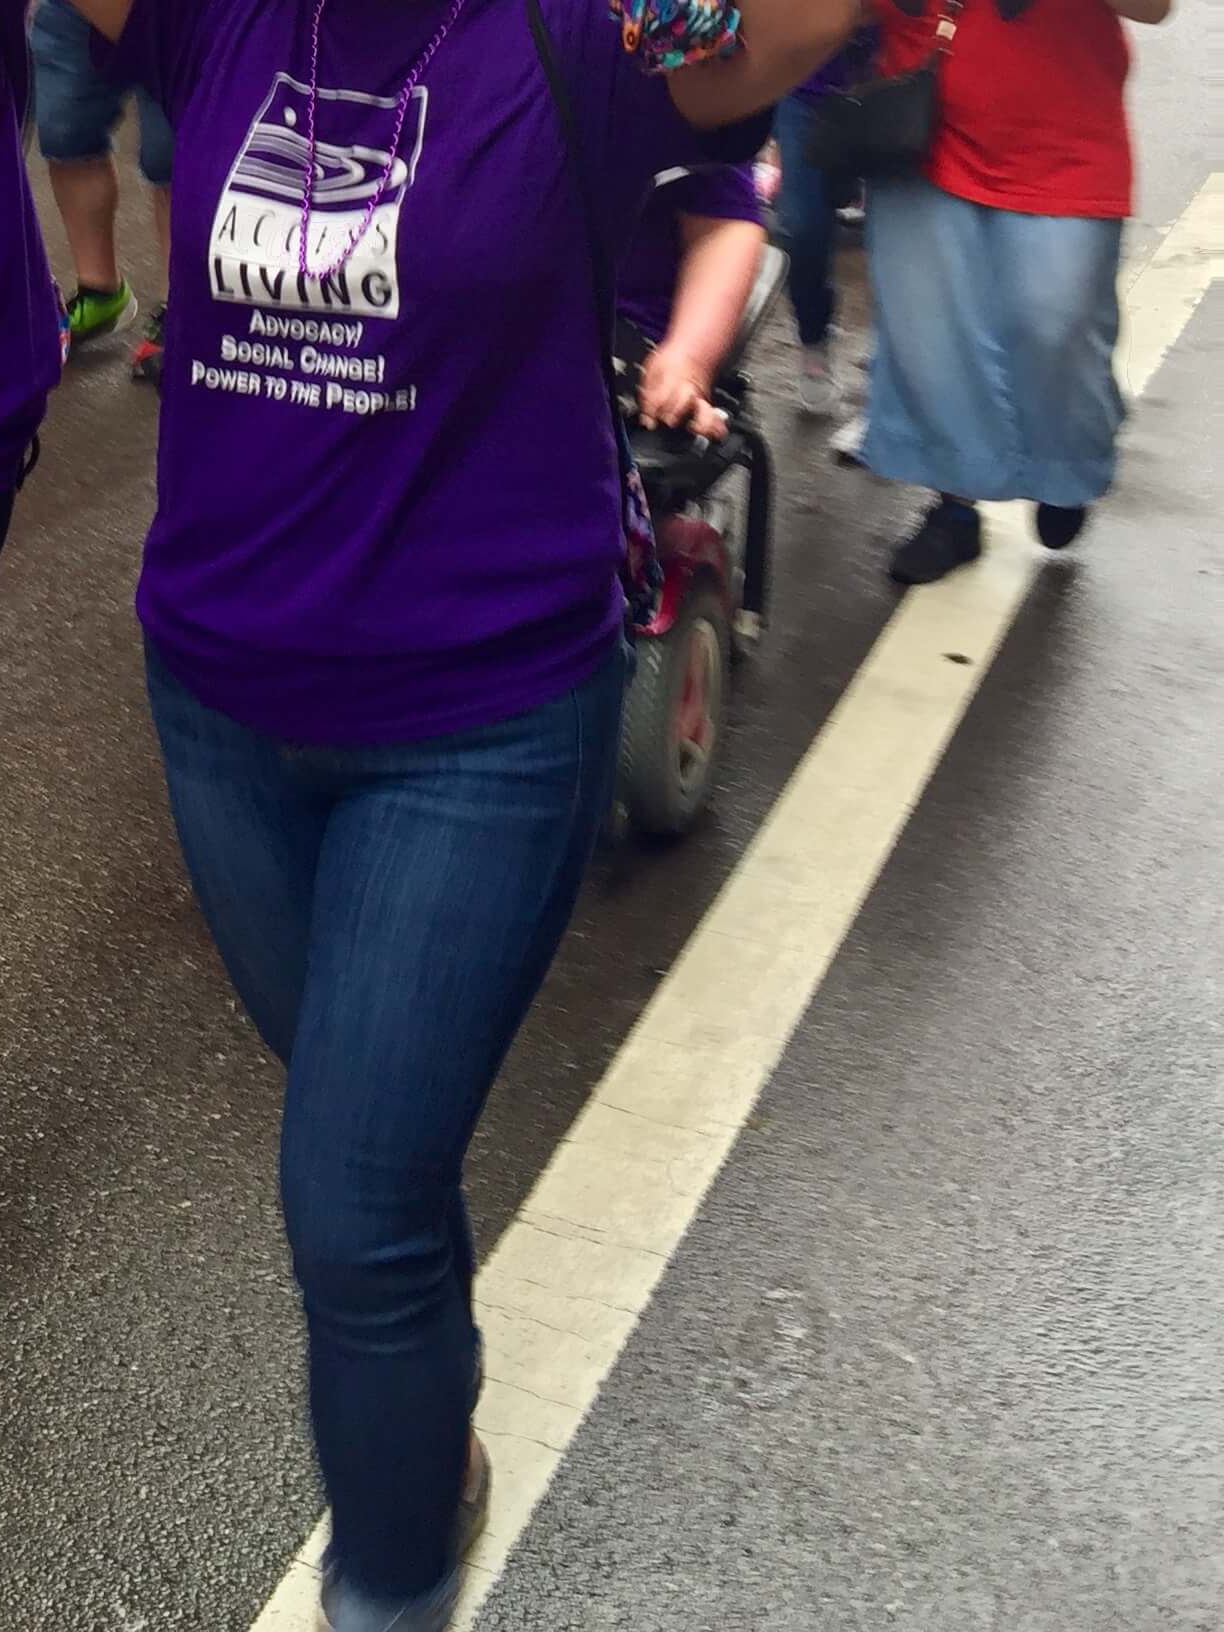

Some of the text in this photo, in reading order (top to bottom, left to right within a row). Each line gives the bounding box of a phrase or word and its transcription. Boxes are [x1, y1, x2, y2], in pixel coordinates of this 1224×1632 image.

[214, 256, 392, 308] LIVING
[249, 309, 364, 349] ADVOCACY!
[221, 334, 386, 384] SOCIAL CHANGE!
[191, 359, 418, 416] POWER TO THE PEOPLE!
